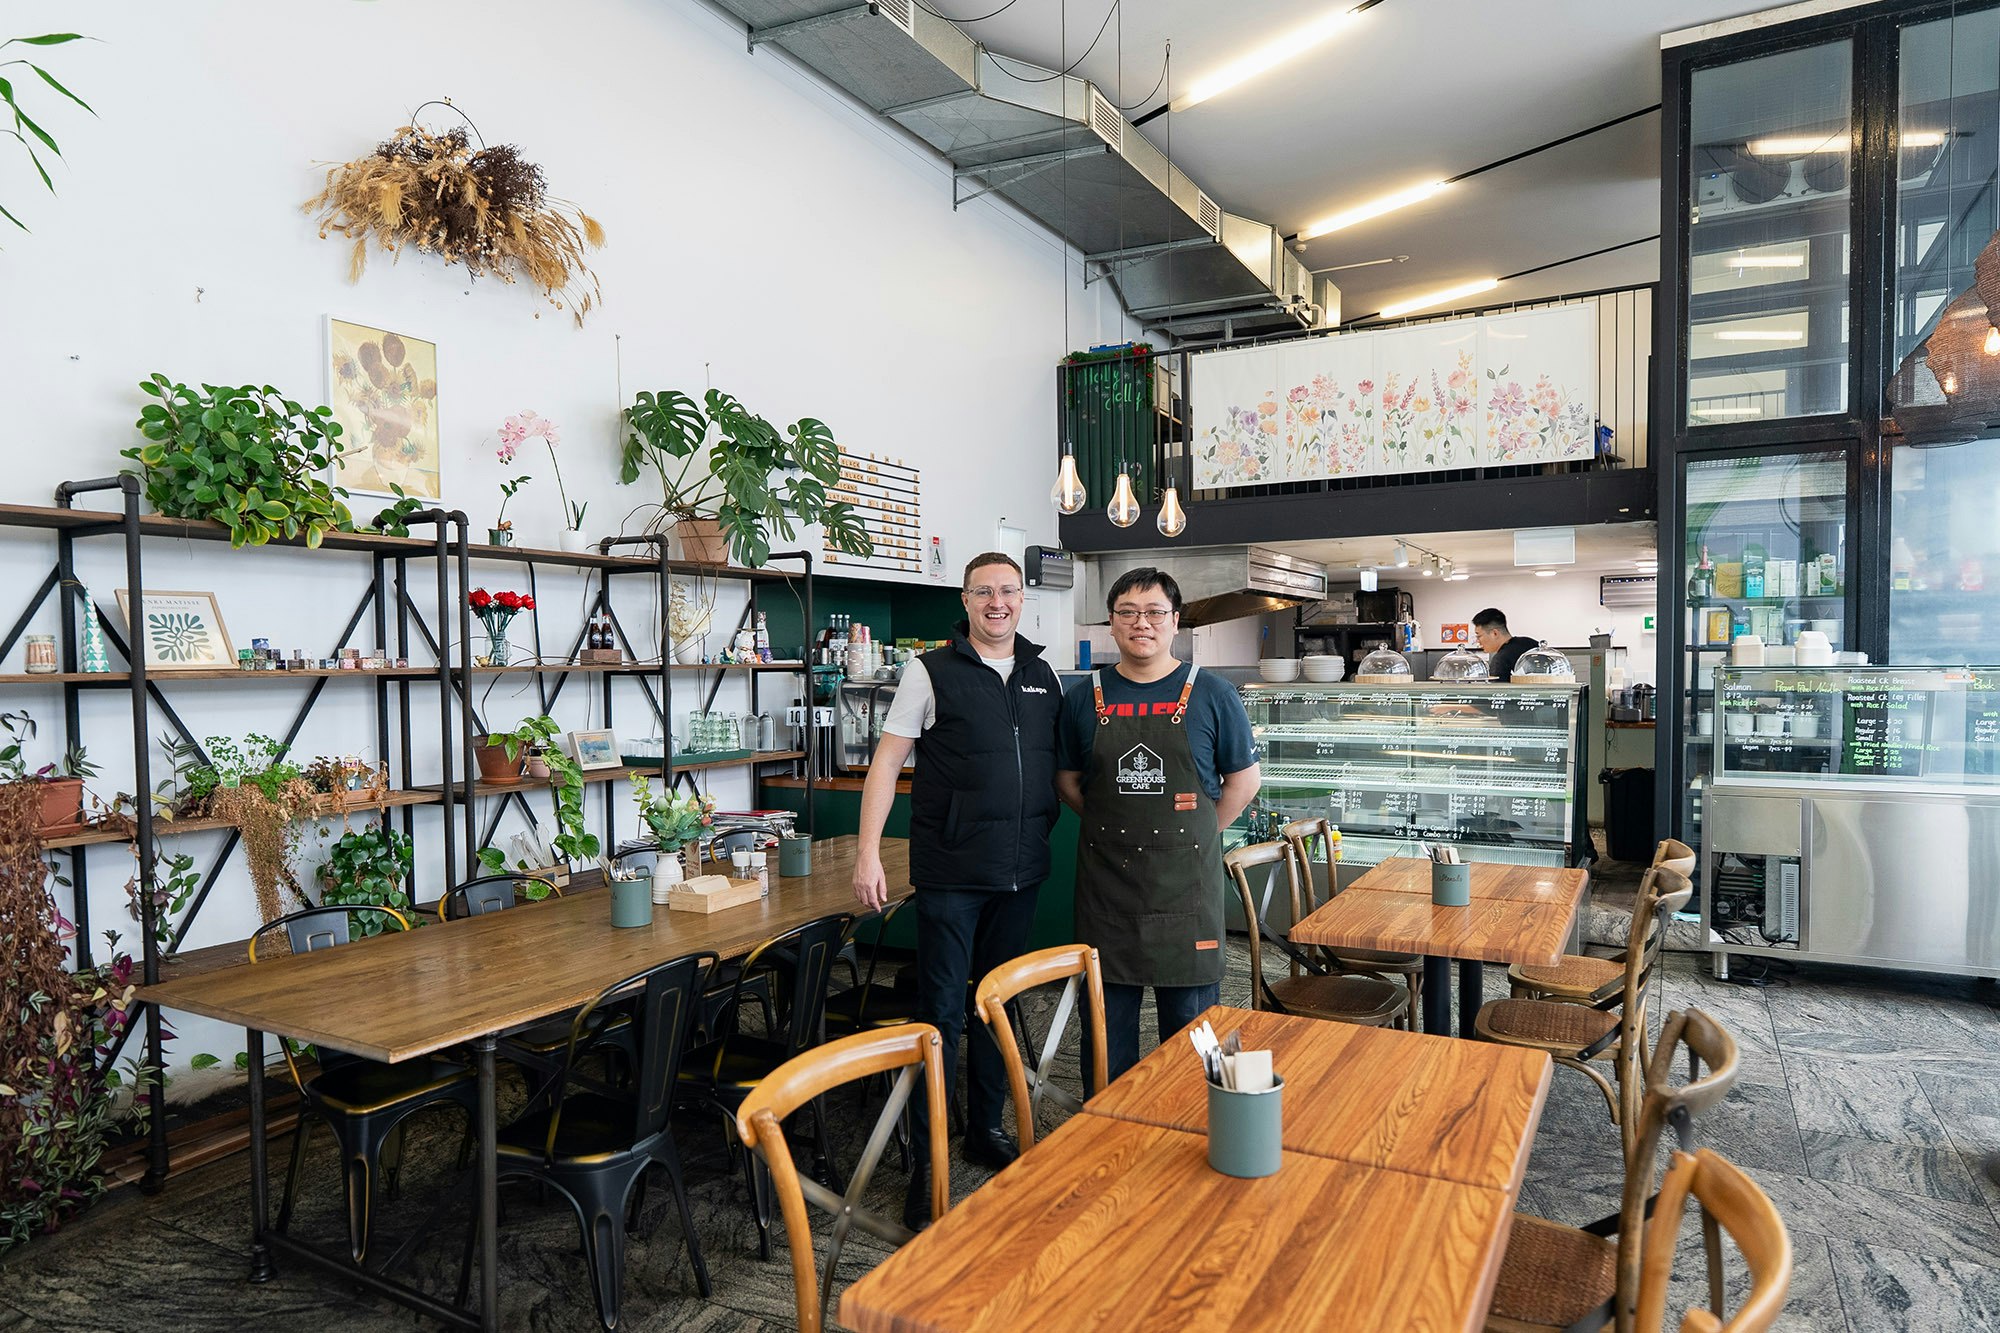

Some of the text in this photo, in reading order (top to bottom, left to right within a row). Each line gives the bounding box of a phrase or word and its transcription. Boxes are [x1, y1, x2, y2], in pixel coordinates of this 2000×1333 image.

[933, 548, 941, 564] A
[1848, 676, 1876, 684] Roasted
[1723, 682, 1752, 691] Salmon
[1776, 703, 1794, 711] Large
[790, 711, 800, 723] 10
[815, 711, 821, 723] 9
[826, 711, 832, 723] 7
[1857, 718, 1876, 726] Large
[1975, 719, 1996, 728] Large
[1855, 727, 1876, 735] Regular
[1974, 727, 1999, 735] Regular
[1974, 735, 1995, 743] Small
